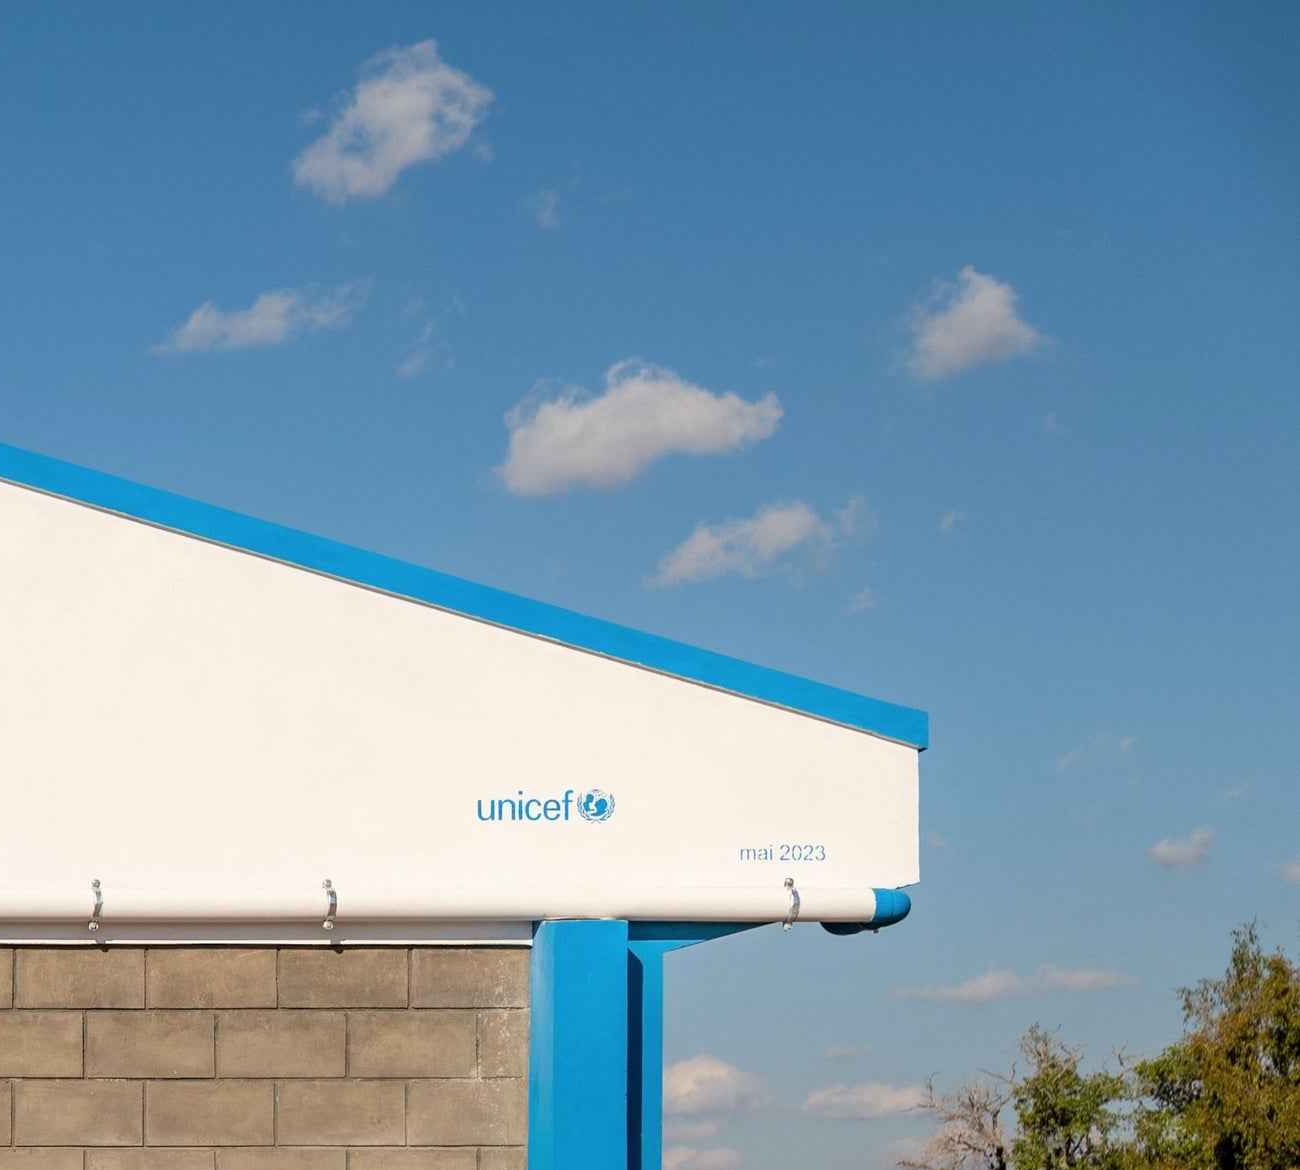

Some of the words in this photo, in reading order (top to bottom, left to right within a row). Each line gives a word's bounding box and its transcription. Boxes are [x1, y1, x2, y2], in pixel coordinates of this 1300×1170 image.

[476, 789, 574, 822] unicef
[739, 843, 773, 862] mai
[779, 844, 826, 862] 2023
